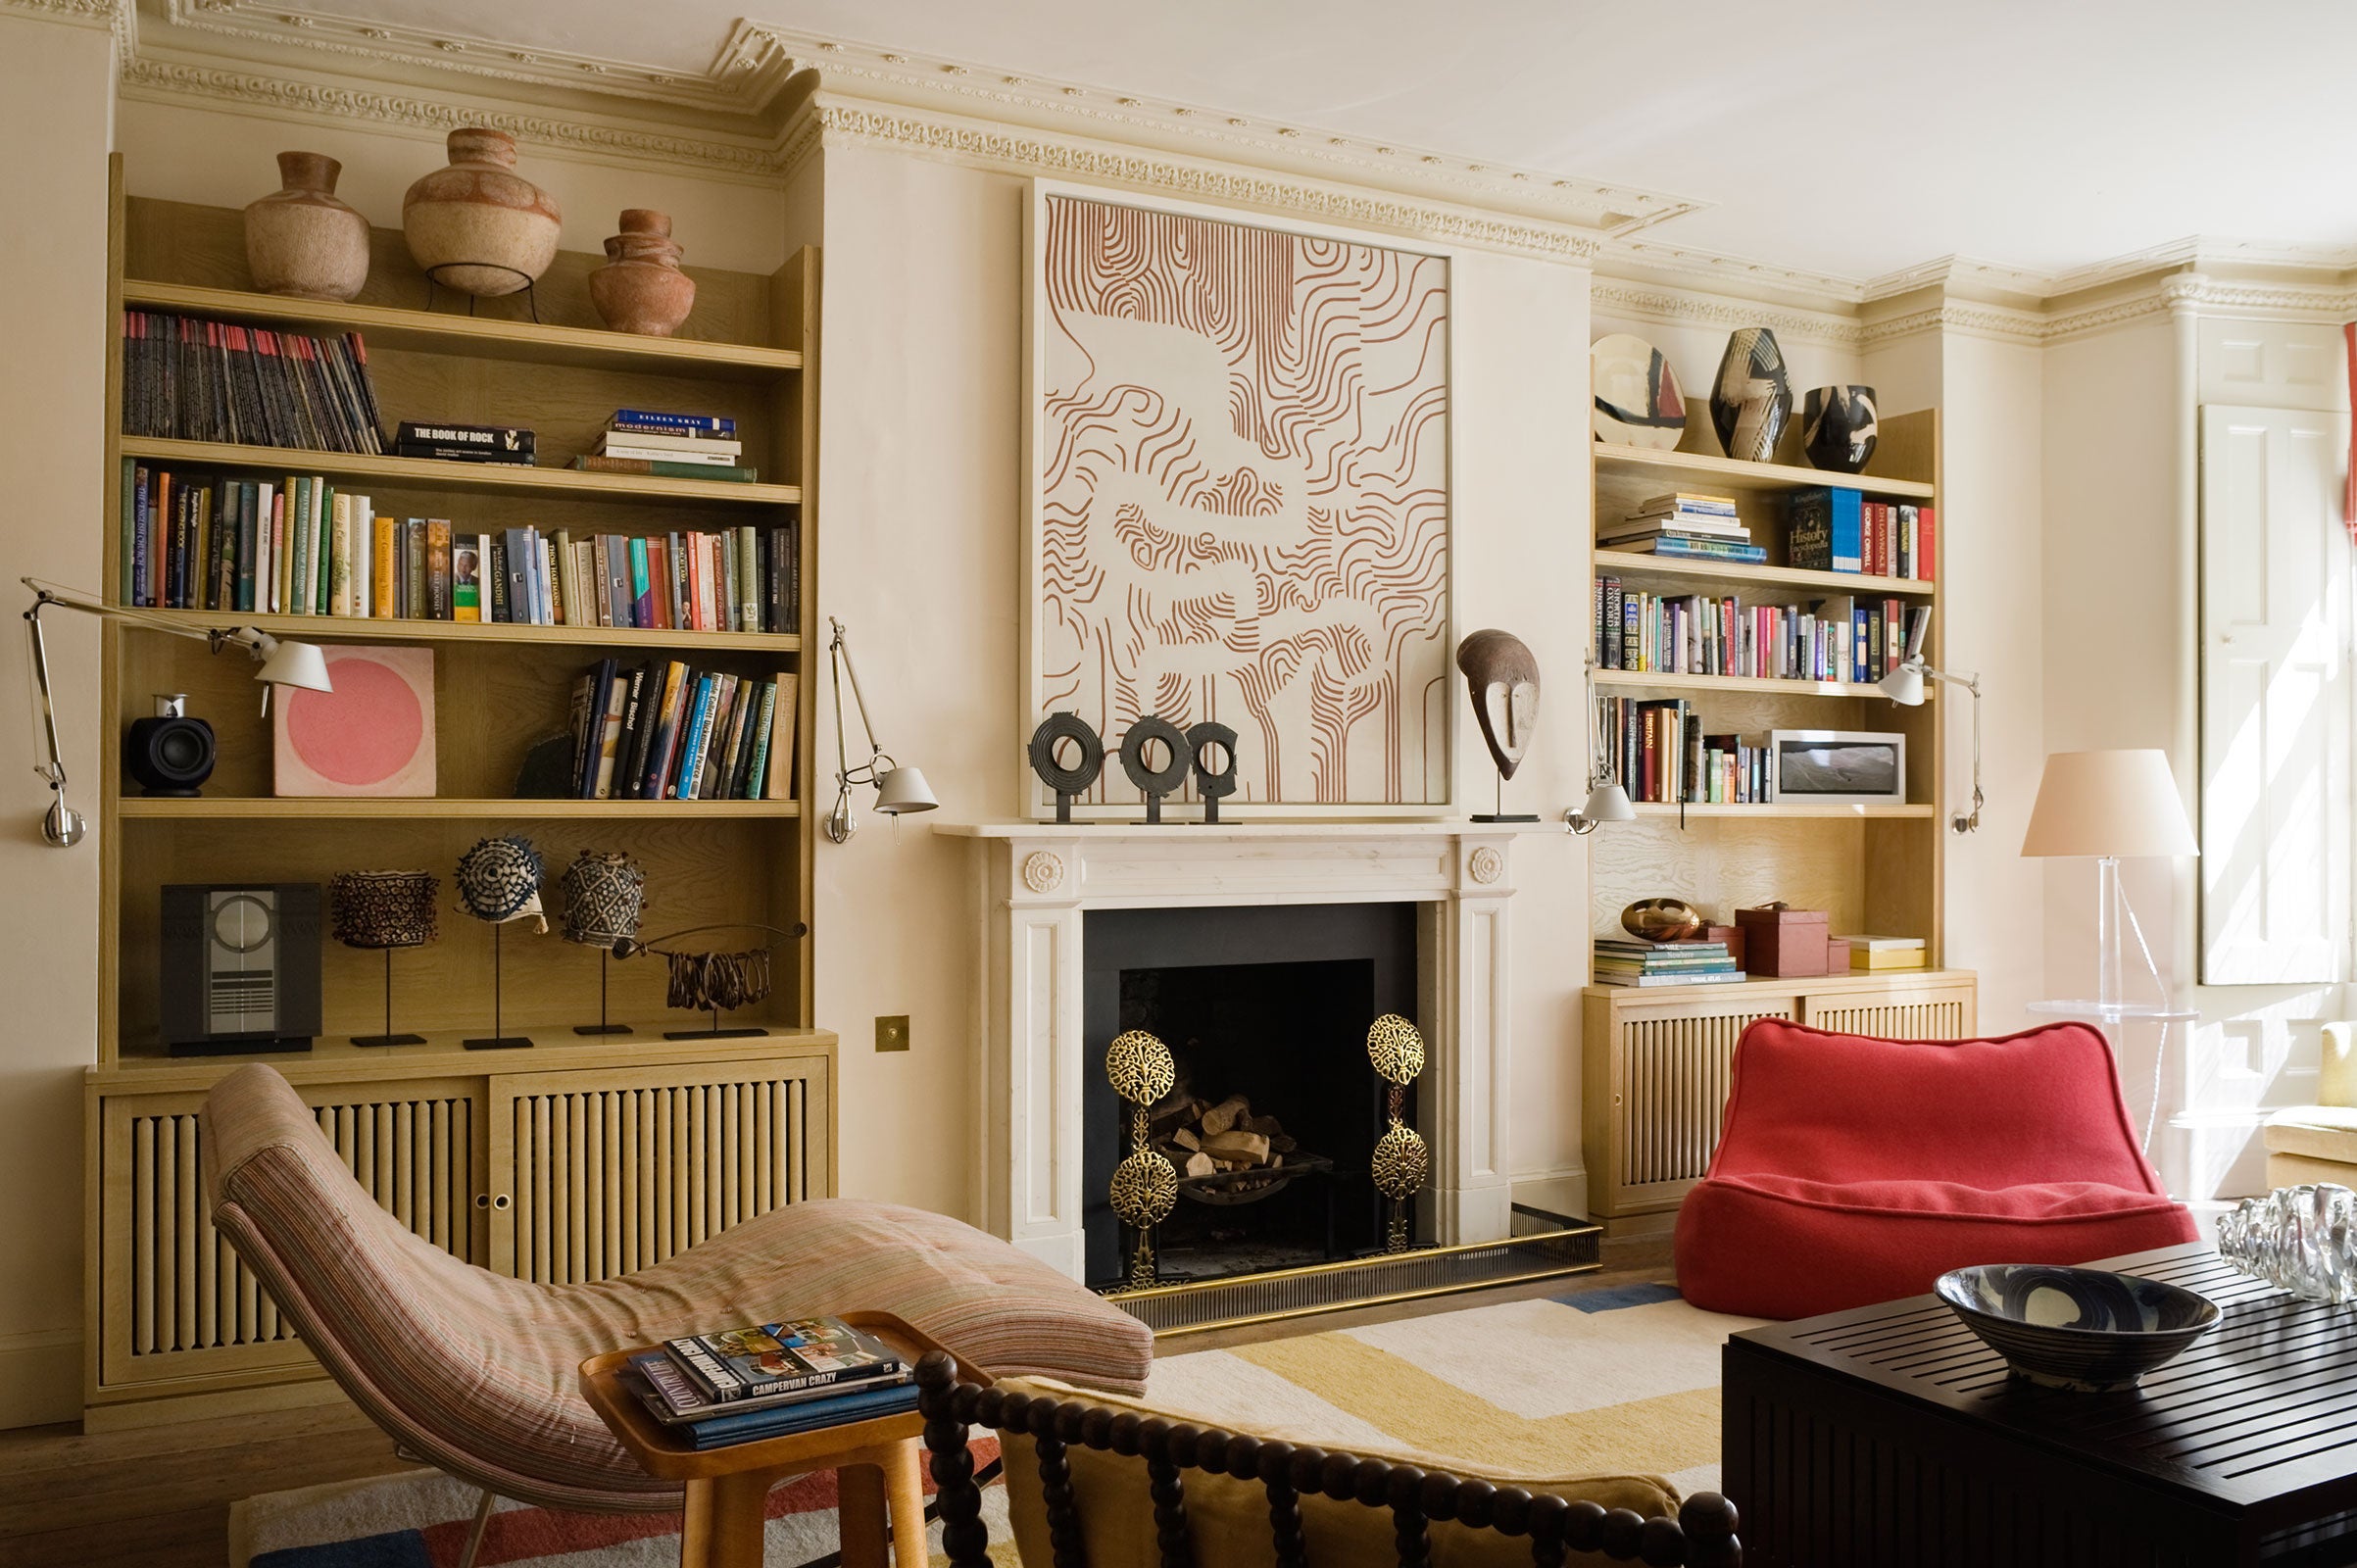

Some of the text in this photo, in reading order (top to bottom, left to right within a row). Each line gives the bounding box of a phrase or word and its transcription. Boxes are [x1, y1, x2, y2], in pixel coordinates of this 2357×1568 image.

[614, 422, 686, 433] modernism
[639, 414, 674, 423] EILEEN
[414, 427, 494, 444] THE BOOK OF ROCK
[1790, 524, 1829, 544] History
[137, 535, 146, 567] CHURCH
[379, 542, 389, 583] Gardening
[494, 570, 504, 605] GANDHI
[551, 567, 561, 607] HARTMANN
[626, 671, 644, 731] Werner Bischof
[764, 686, 775, 705] Ivon
[692, 674, 721, 779] Inside Collett Dickenson Pearce
[759, 705, 772, 742] Hitchens
[644, 1358, 700, 1409] COUNTRY LIFE
[752, 1376, 808, 1396] CAMPERVAN
[808, 1371, 837, 1387] CRAZY
